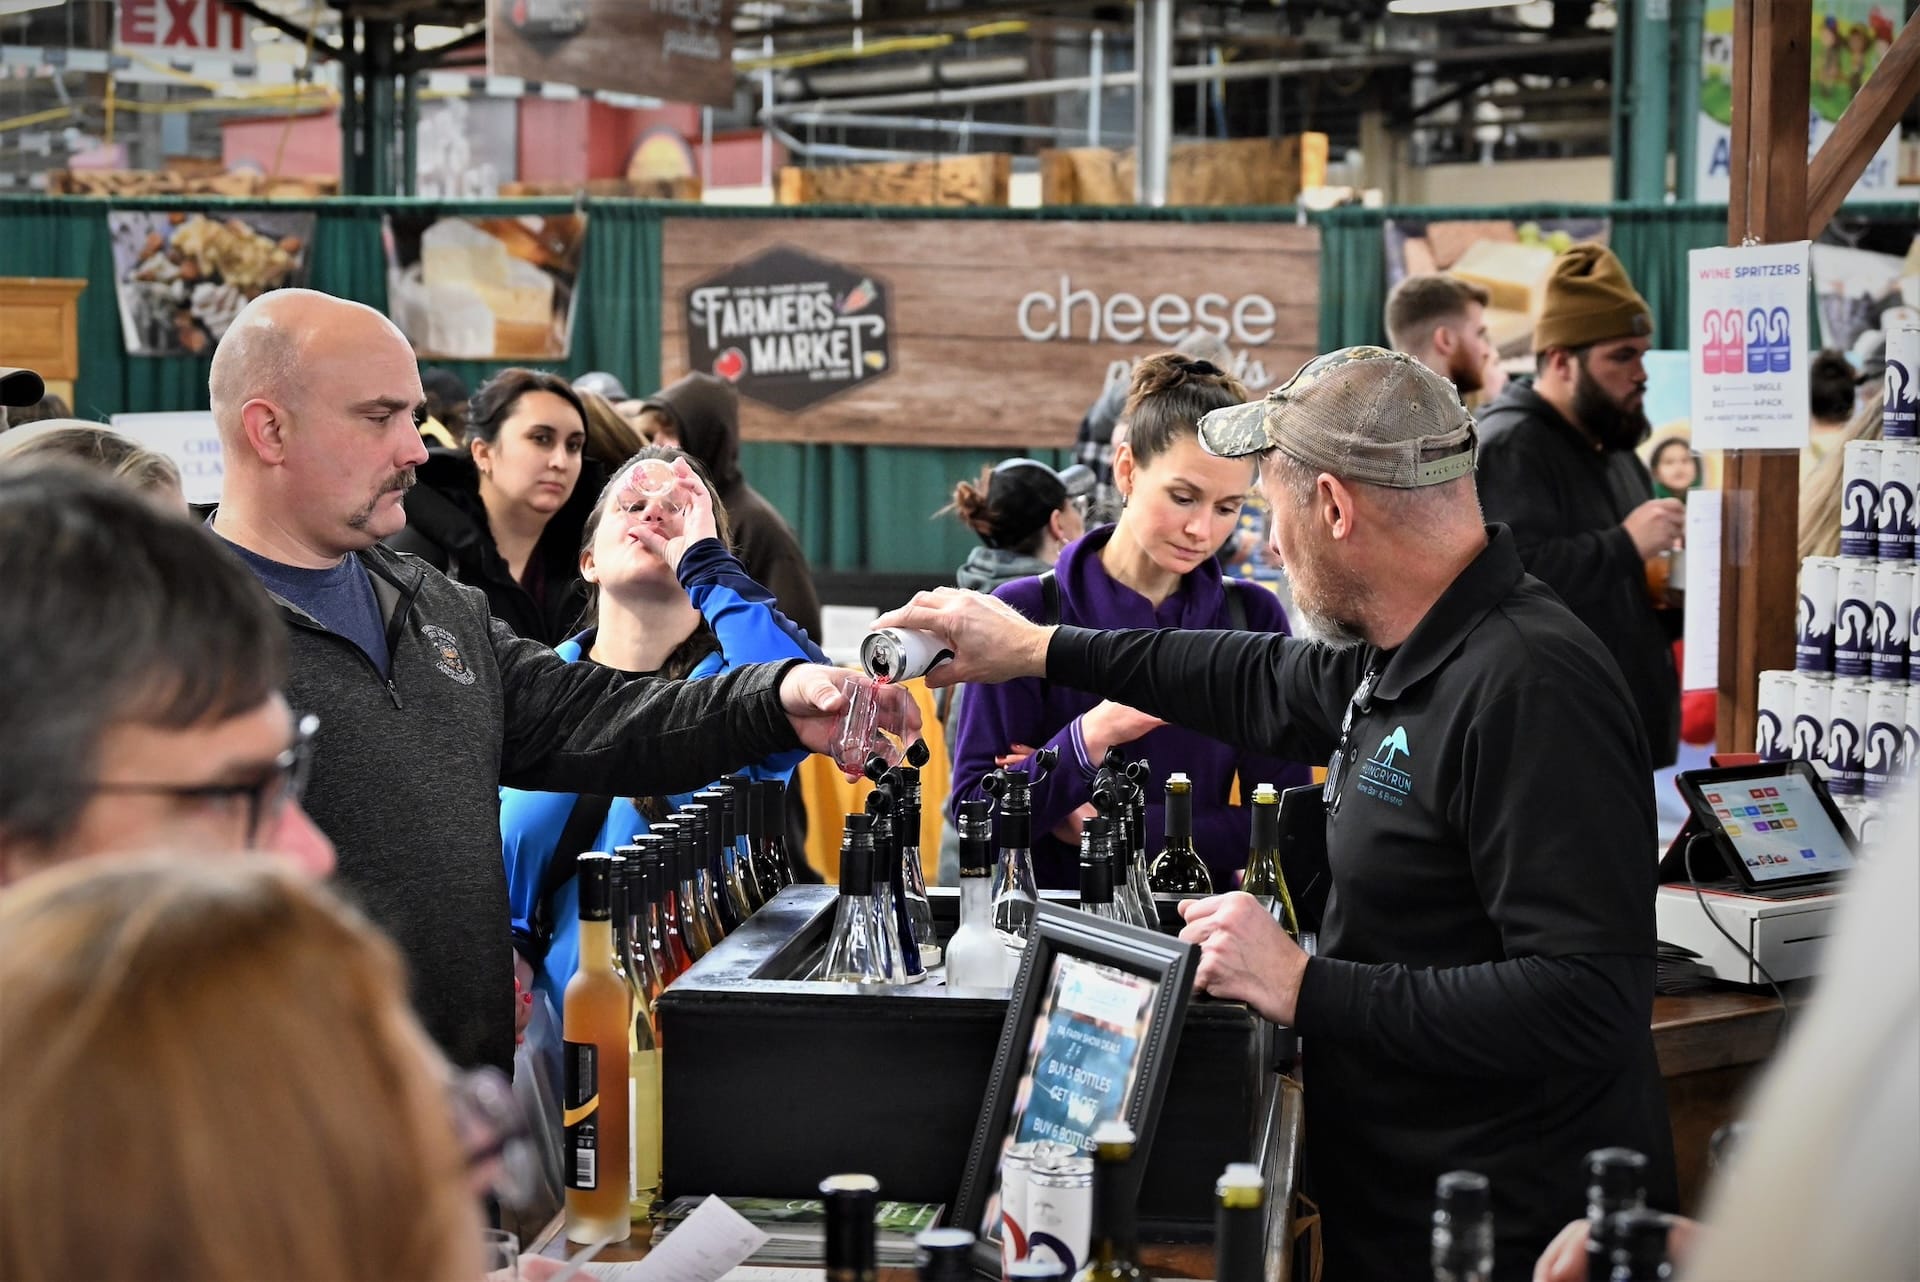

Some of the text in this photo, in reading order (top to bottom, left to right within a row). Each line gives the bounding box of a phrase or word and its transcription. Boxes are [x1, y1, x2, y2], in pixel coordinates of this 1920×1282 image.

[121, 0, 243, 50] EXIT
[1699, 263, 1801, 279] WINE SPRITZERS
[689, 286, 836, 349] FARMERS
[1018, 274, 1276, 345] cheese
[751, 314, 886, 379] MARKET
[1048, 1059, 1112, 1093] BUY 3 BOTTLES
[1050, 1085, 1069, 1102] GET
[1033, 1117, 1098, 1152] BUY 6 BOTTLES
